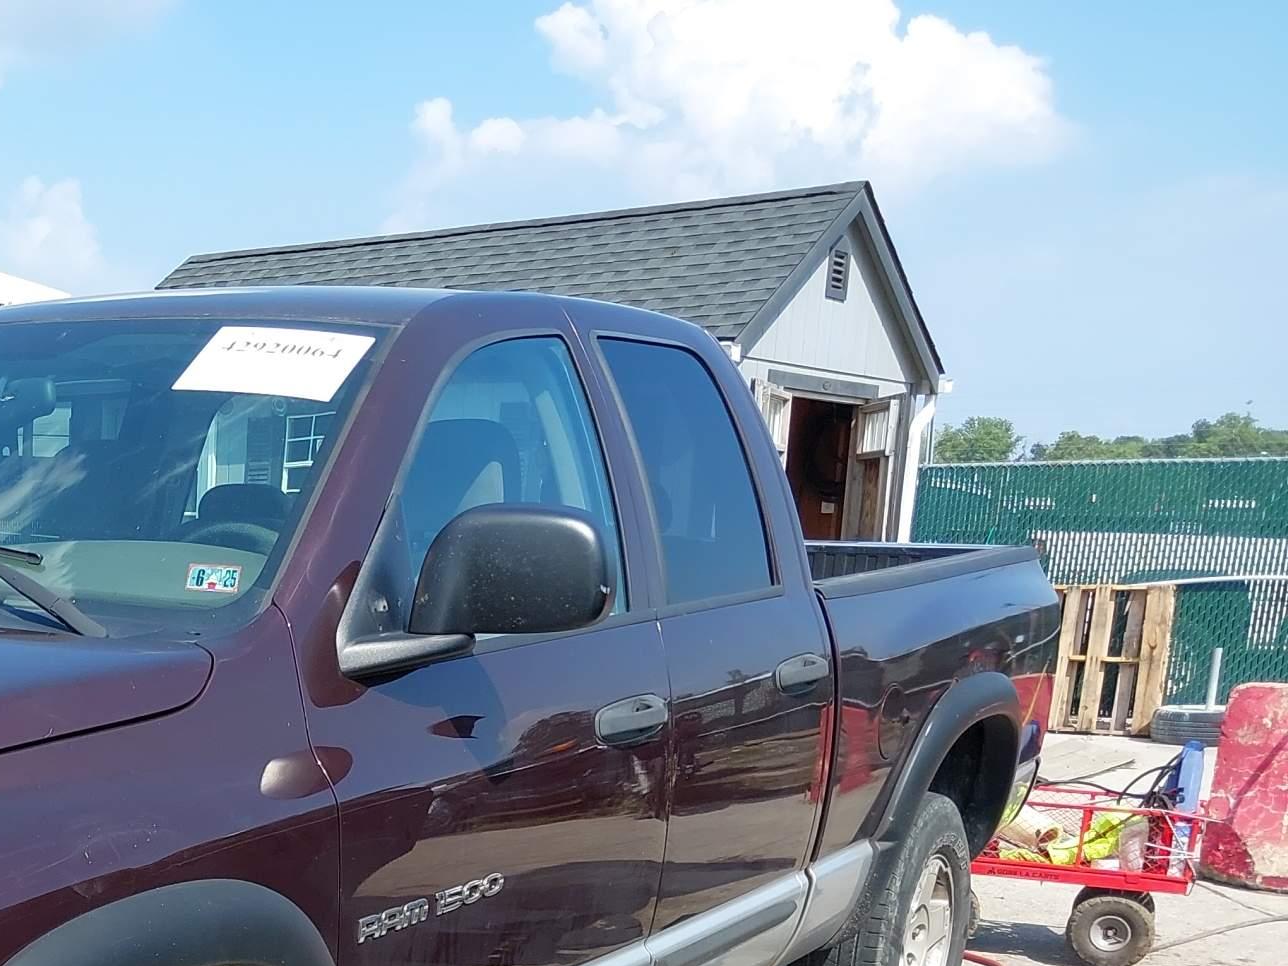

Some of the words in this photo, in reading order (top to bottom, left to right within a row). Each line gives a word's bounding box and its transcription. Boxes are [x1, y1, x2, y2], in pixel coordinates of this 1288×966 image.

[223, 569, 238, 588] 25
[358, 898, 429, 943] RAM
[435, 872, 505, 915] 1500
